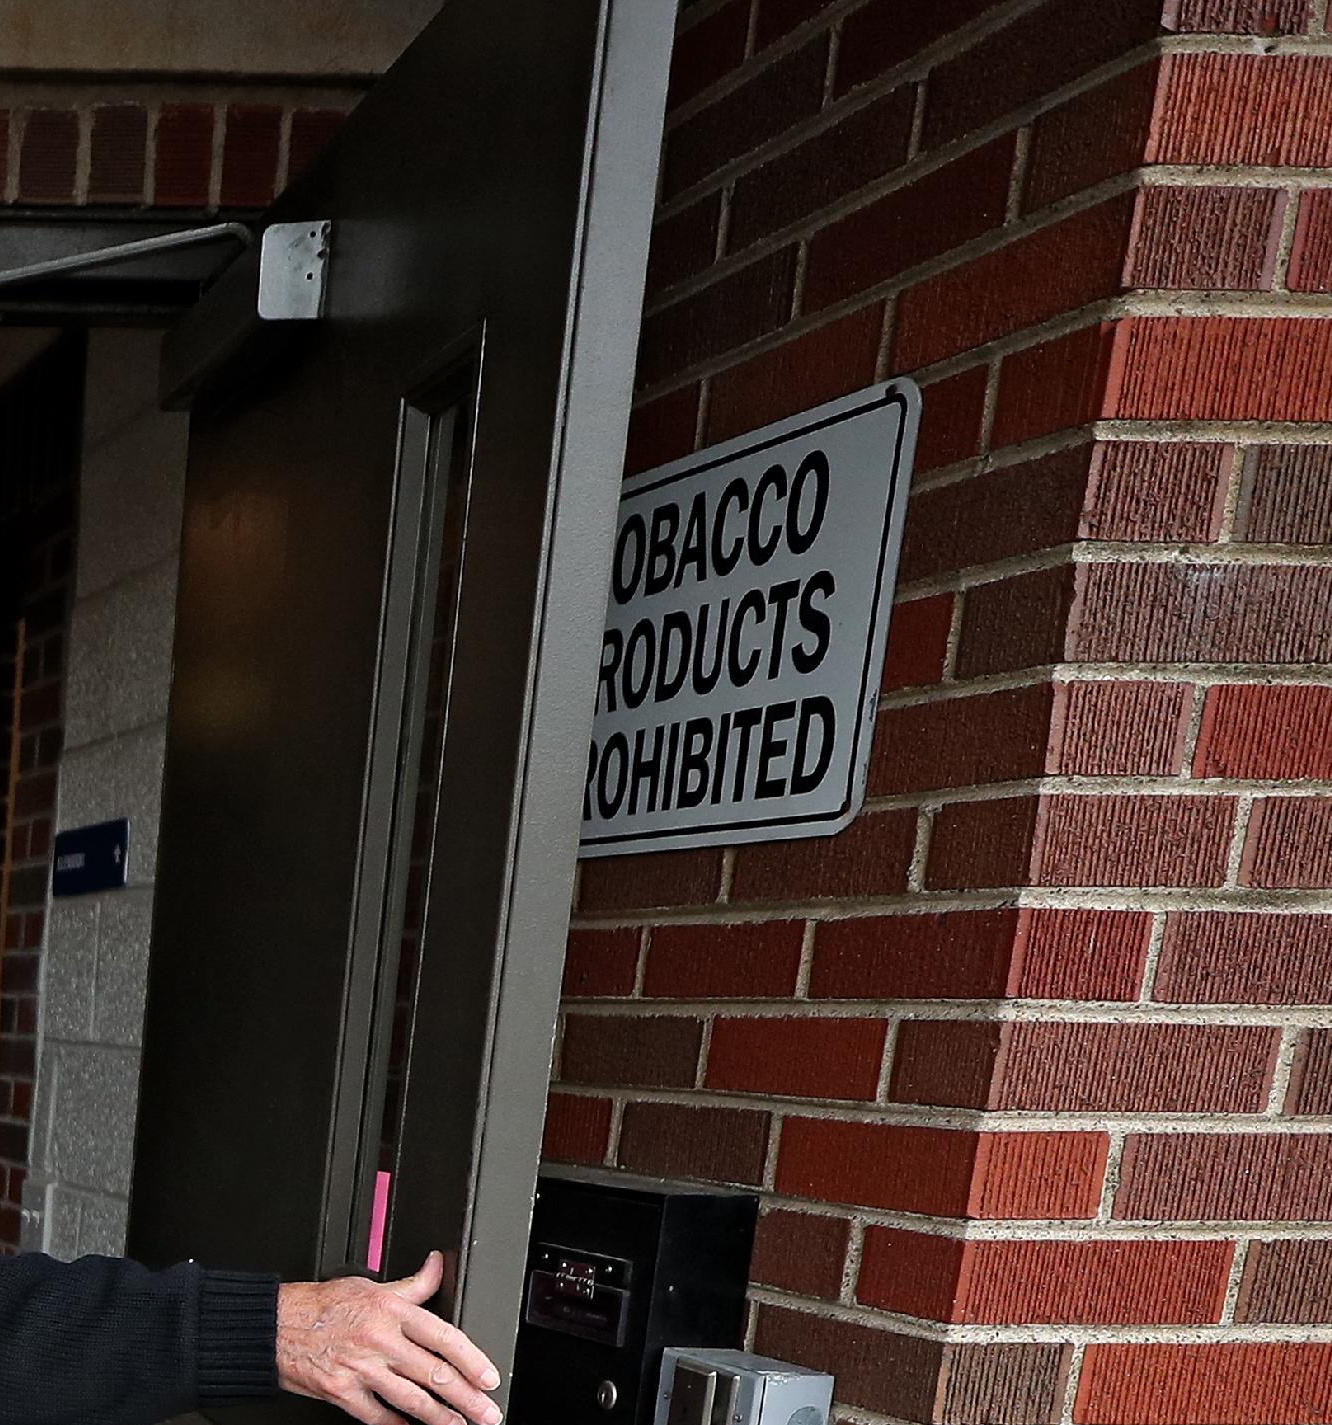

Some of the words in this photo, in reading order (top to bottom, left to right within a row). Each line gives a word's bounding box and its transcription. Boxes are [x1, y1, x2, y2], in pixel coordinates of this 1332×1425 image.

[611, 450, 830, 605] OBACCO
[595, 570, 836, 717] RODUCTS
[582, 695, 836, 821] OHIBITED
